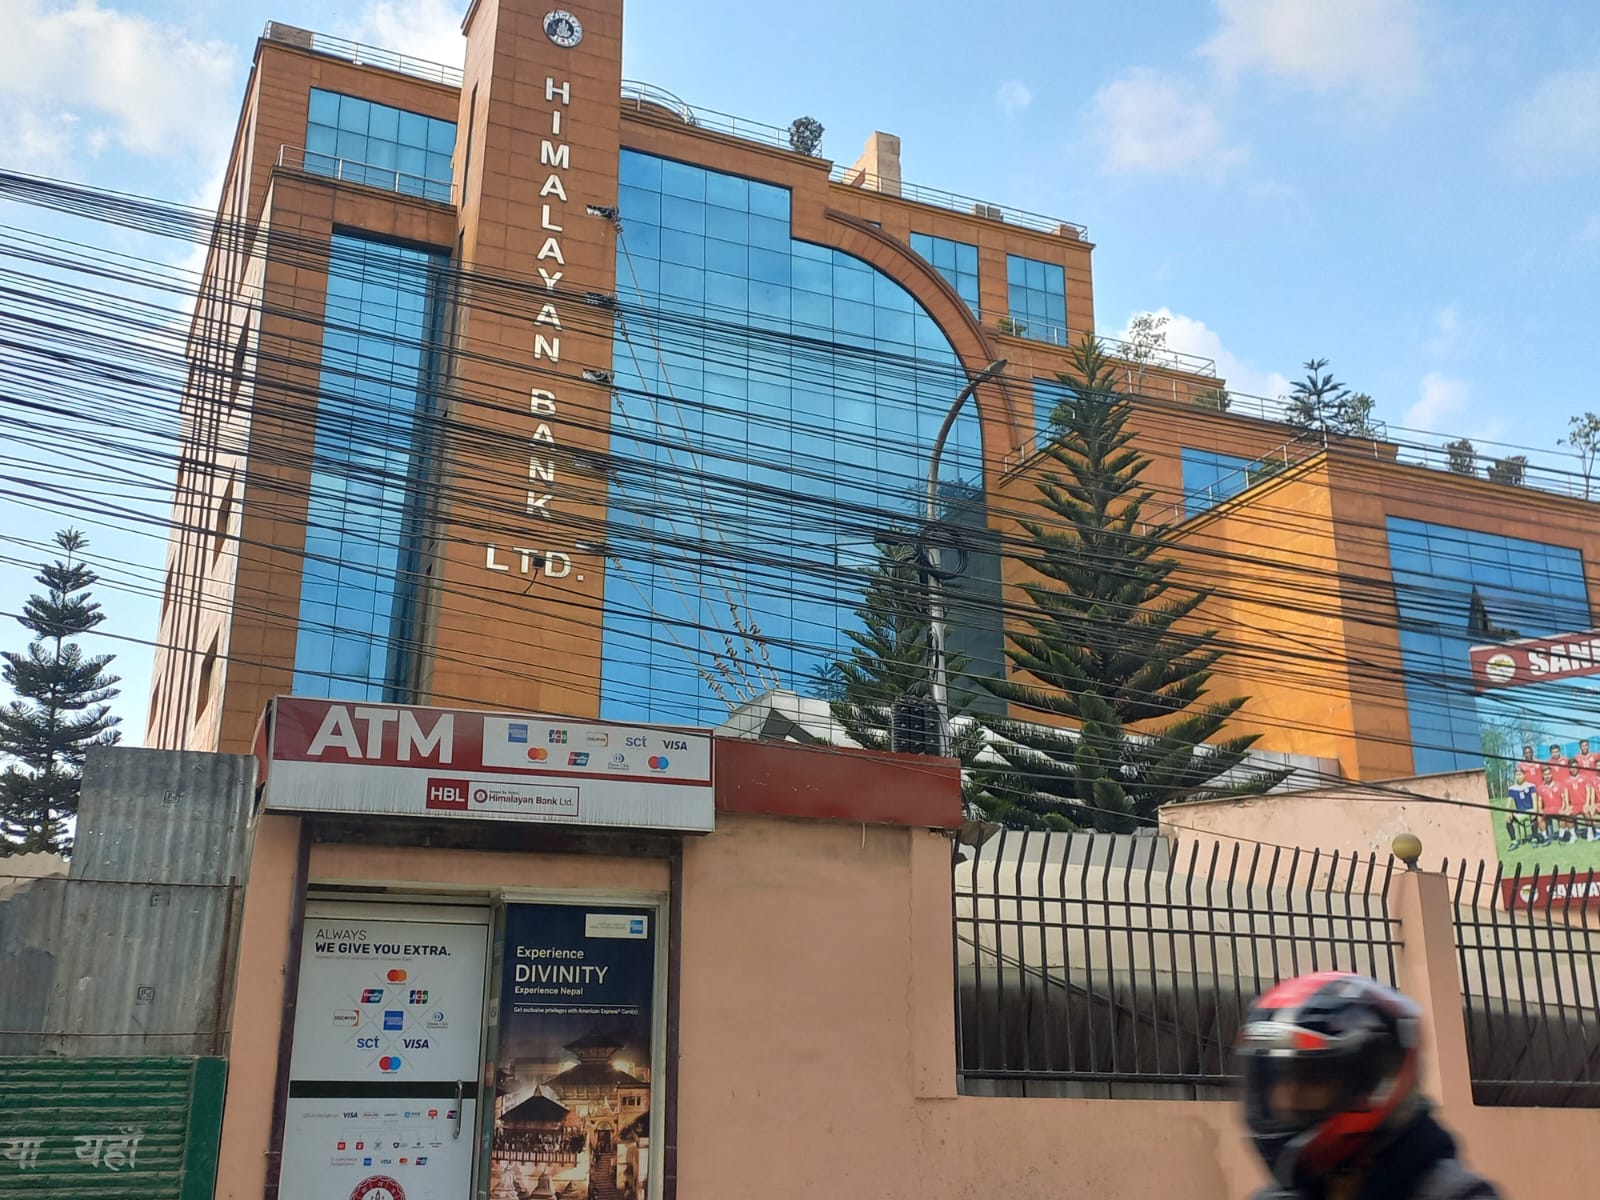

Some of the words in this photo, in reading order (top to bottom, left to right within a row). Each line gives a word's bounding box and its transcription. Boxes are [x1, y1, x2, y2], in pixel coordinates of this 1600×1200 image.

[533, 77, 570, 363] HIMALAYAN
[526, 387, 557, 519] BANK
[485, 543, 584, 582] LTD.
[307, 705, 455, 764] ATM
[663, 740, 688, 751] VISA
[430, 786, 465, 802] HBL
[489, 793, 534, 806] Himalayan
[535, 796, 558, 806] Bank
[559, 798, 575, 807] Ltd.
[316, 928, 367, 941] ALWAYS
[315, 942, 336, 953] WE
[338, 943, 371, 954] GIVE
[373, 943, 401, 955] YOU
[404, 945, 452, 956] EXTRA.
[516, 945, 585, 960] Experience
[515, 964, 609, 985] DIVINITY
[514, 986, 559, 996] Experience
[560, 987, 584, 997] Nepal
[402, 1039, 430, 1049] VISA
[343, 1111, 358, 1119] VISA
